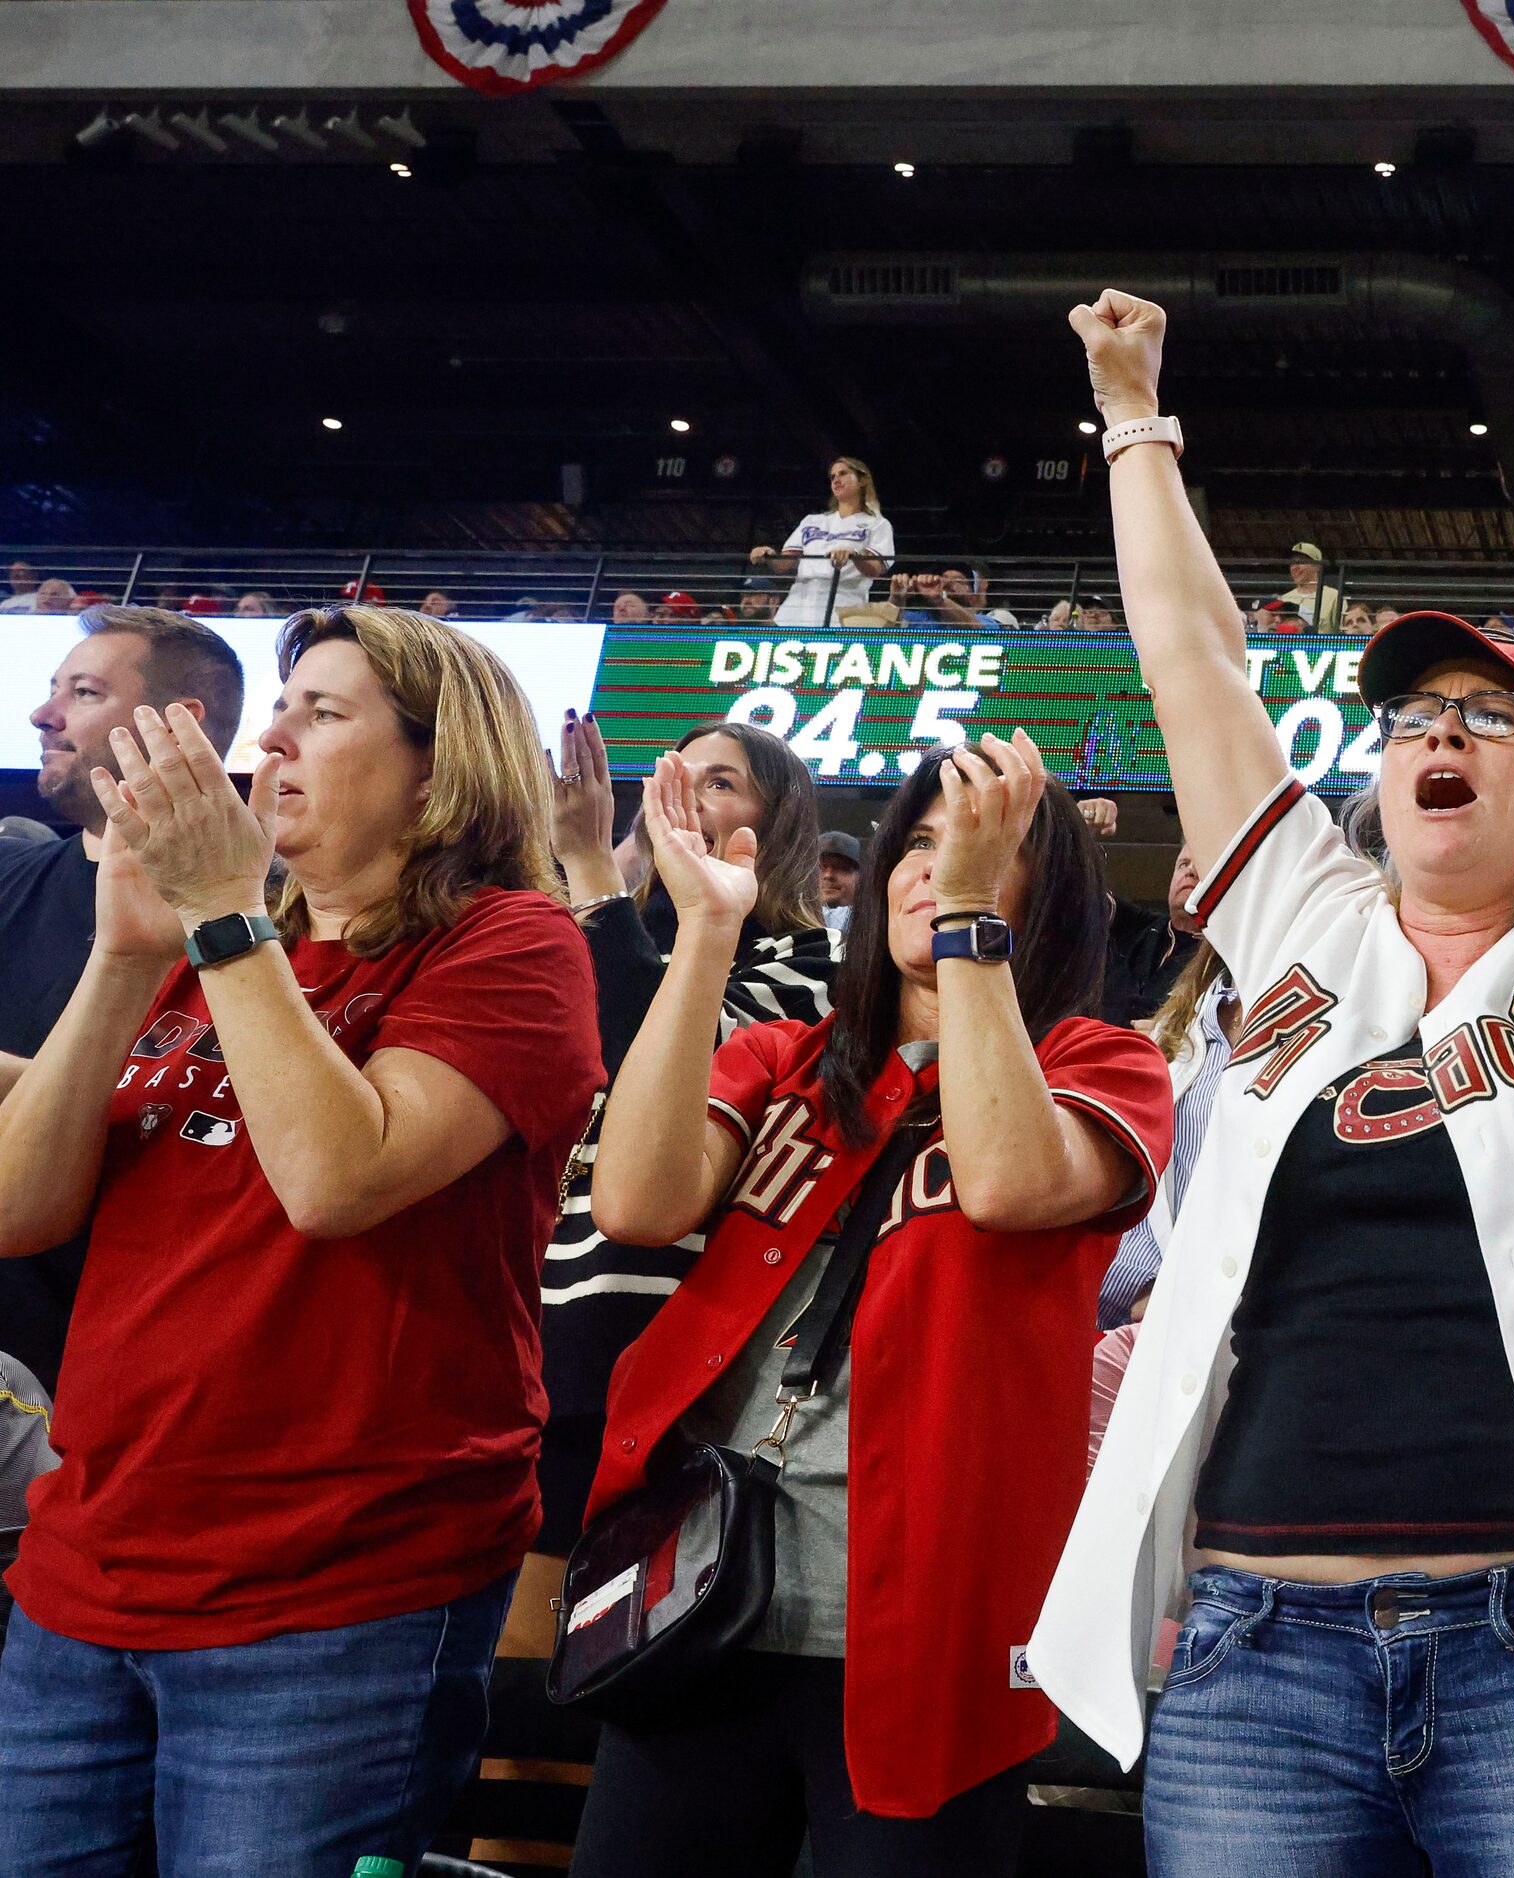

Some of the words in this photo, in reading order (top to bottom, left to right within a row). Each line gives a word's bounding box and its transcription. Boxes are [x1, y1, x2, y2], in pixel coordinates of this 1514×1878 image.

[656, 456, 687, 478] 110
[1036, 459, 1070, 481] 109
[707, 639, 1004, 689] DISTANCE
